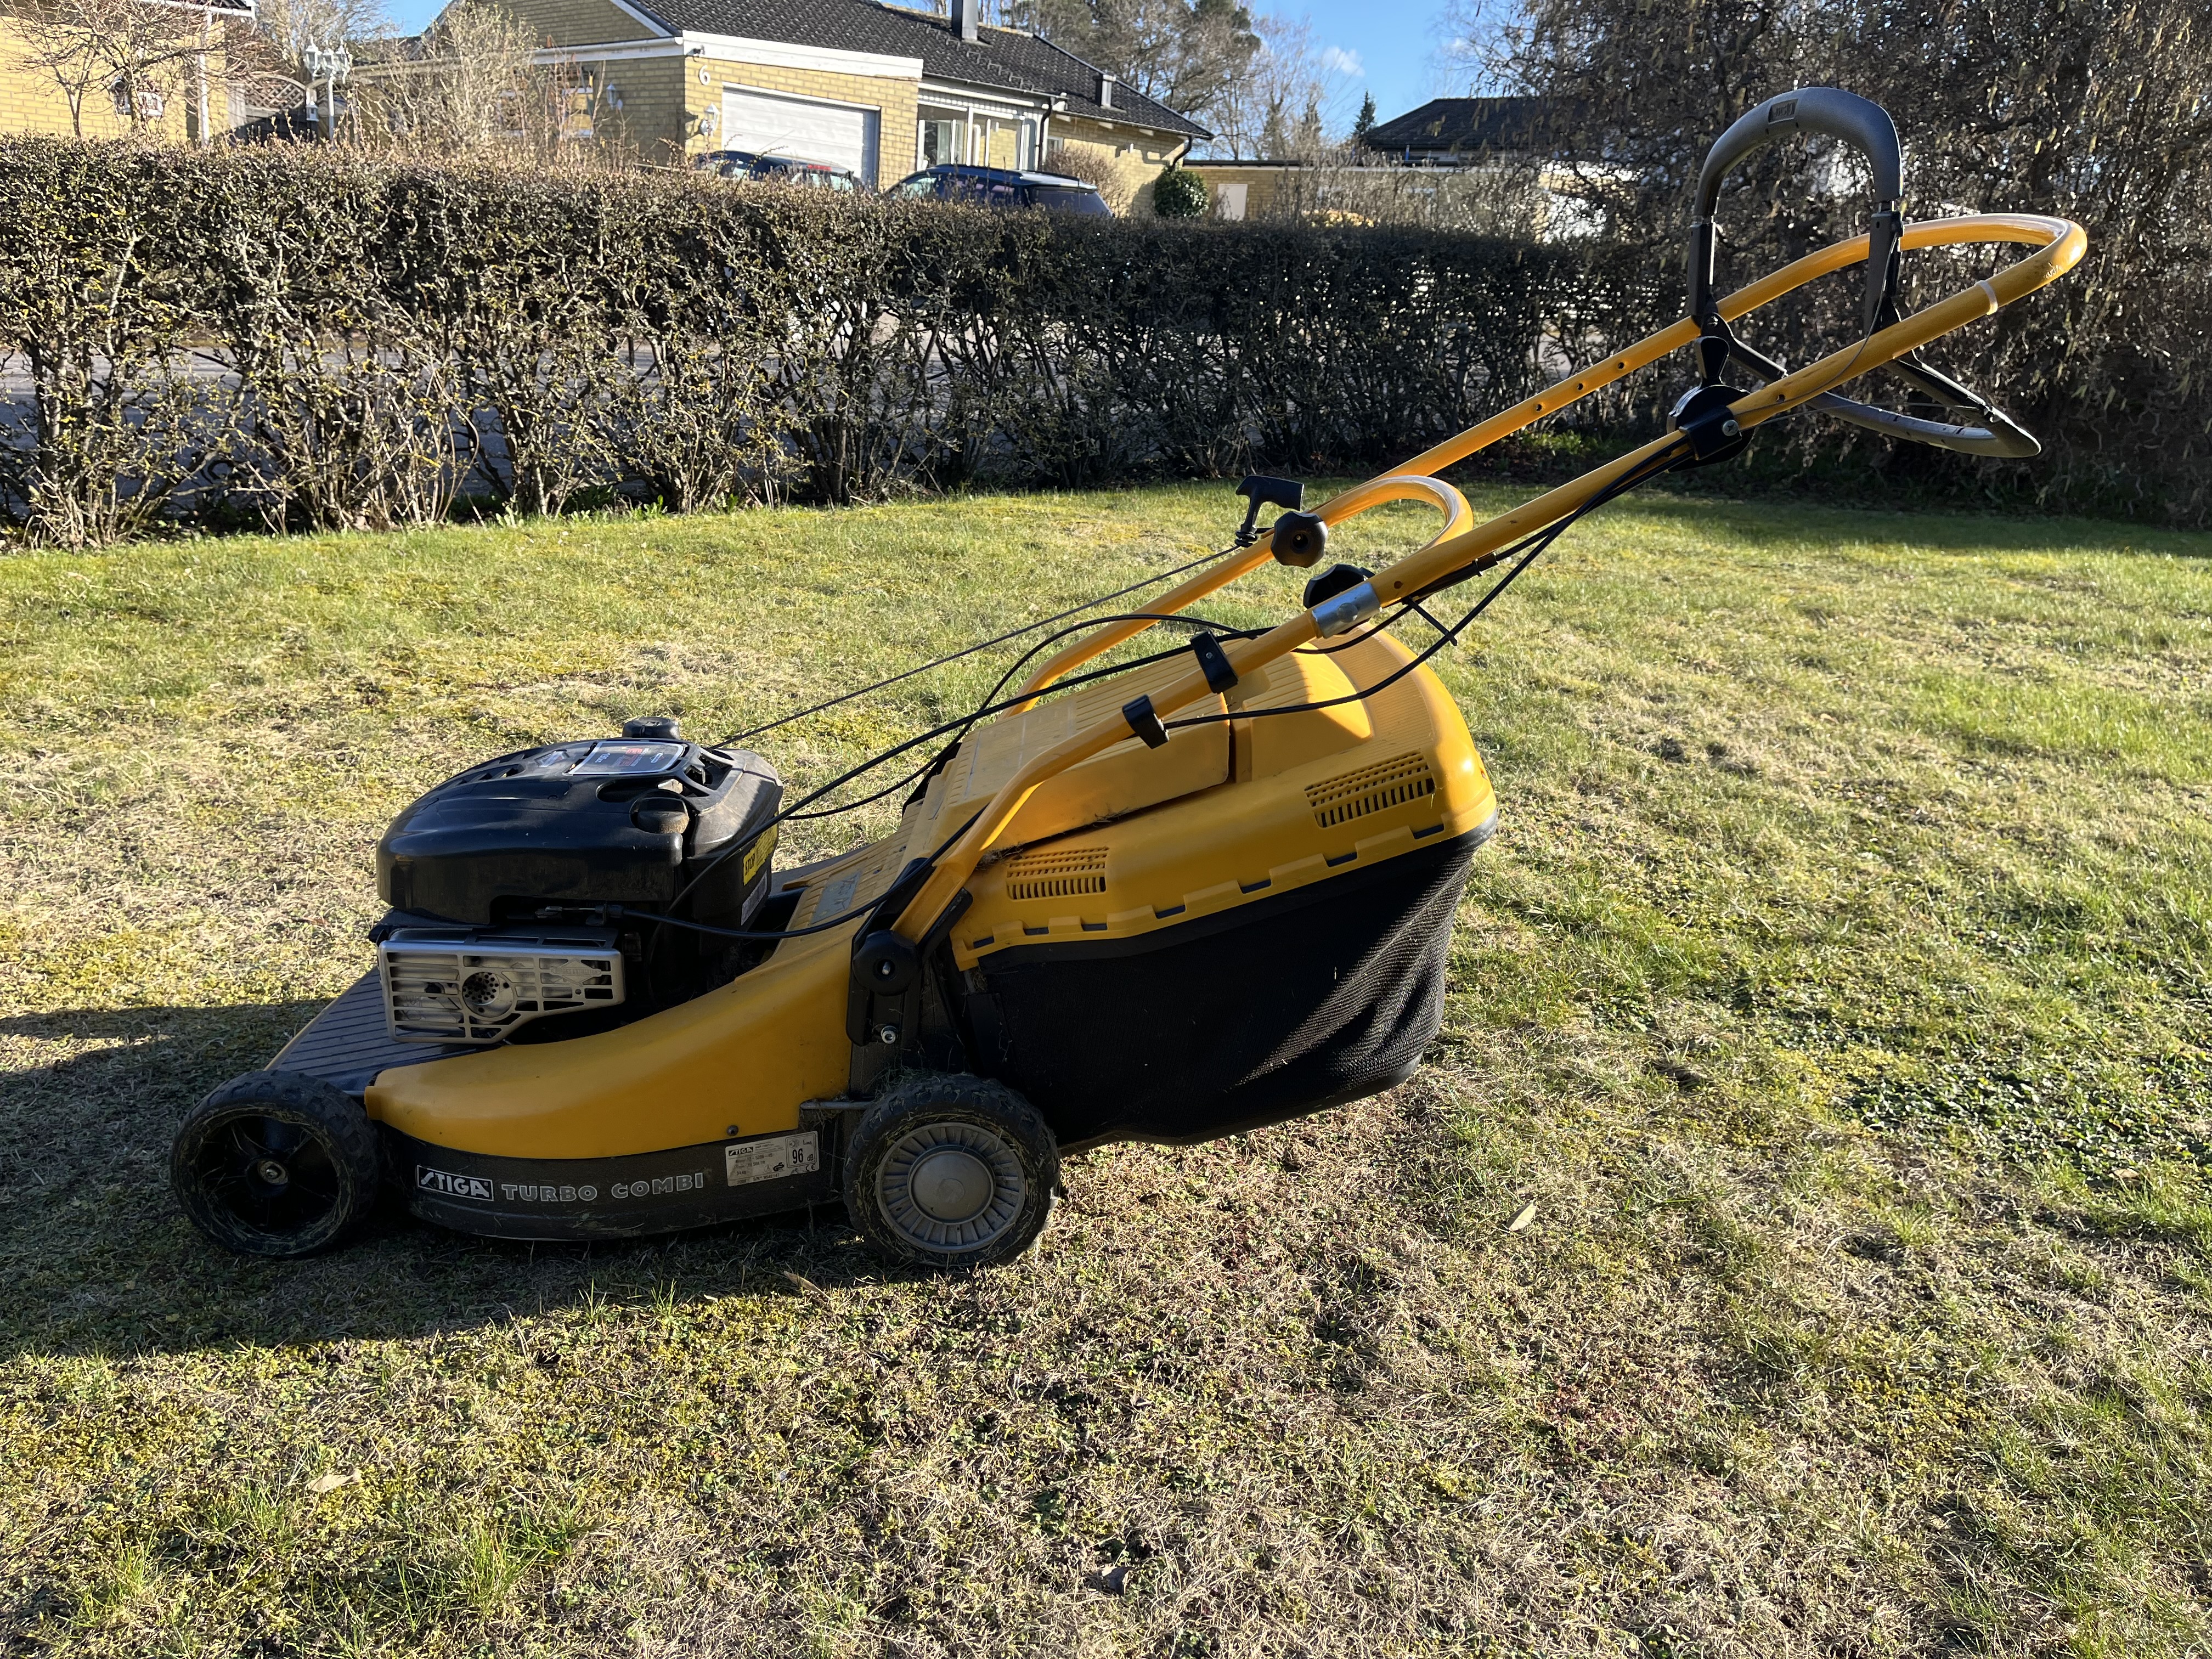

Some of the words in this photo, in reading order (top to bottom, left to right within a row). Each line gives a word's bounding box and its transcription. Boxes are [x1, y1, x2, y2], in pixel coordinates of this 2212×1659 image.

[699, 65, 711, 86] 6
[744, 853, 755, 877] STOP
[729, 1147, 754, 1156] STIGA
[792, 1148, 803, 1164] 96
[501, 1183, 598, 1203] TURBO
[611, 1172, 704, 1200] COMBI
